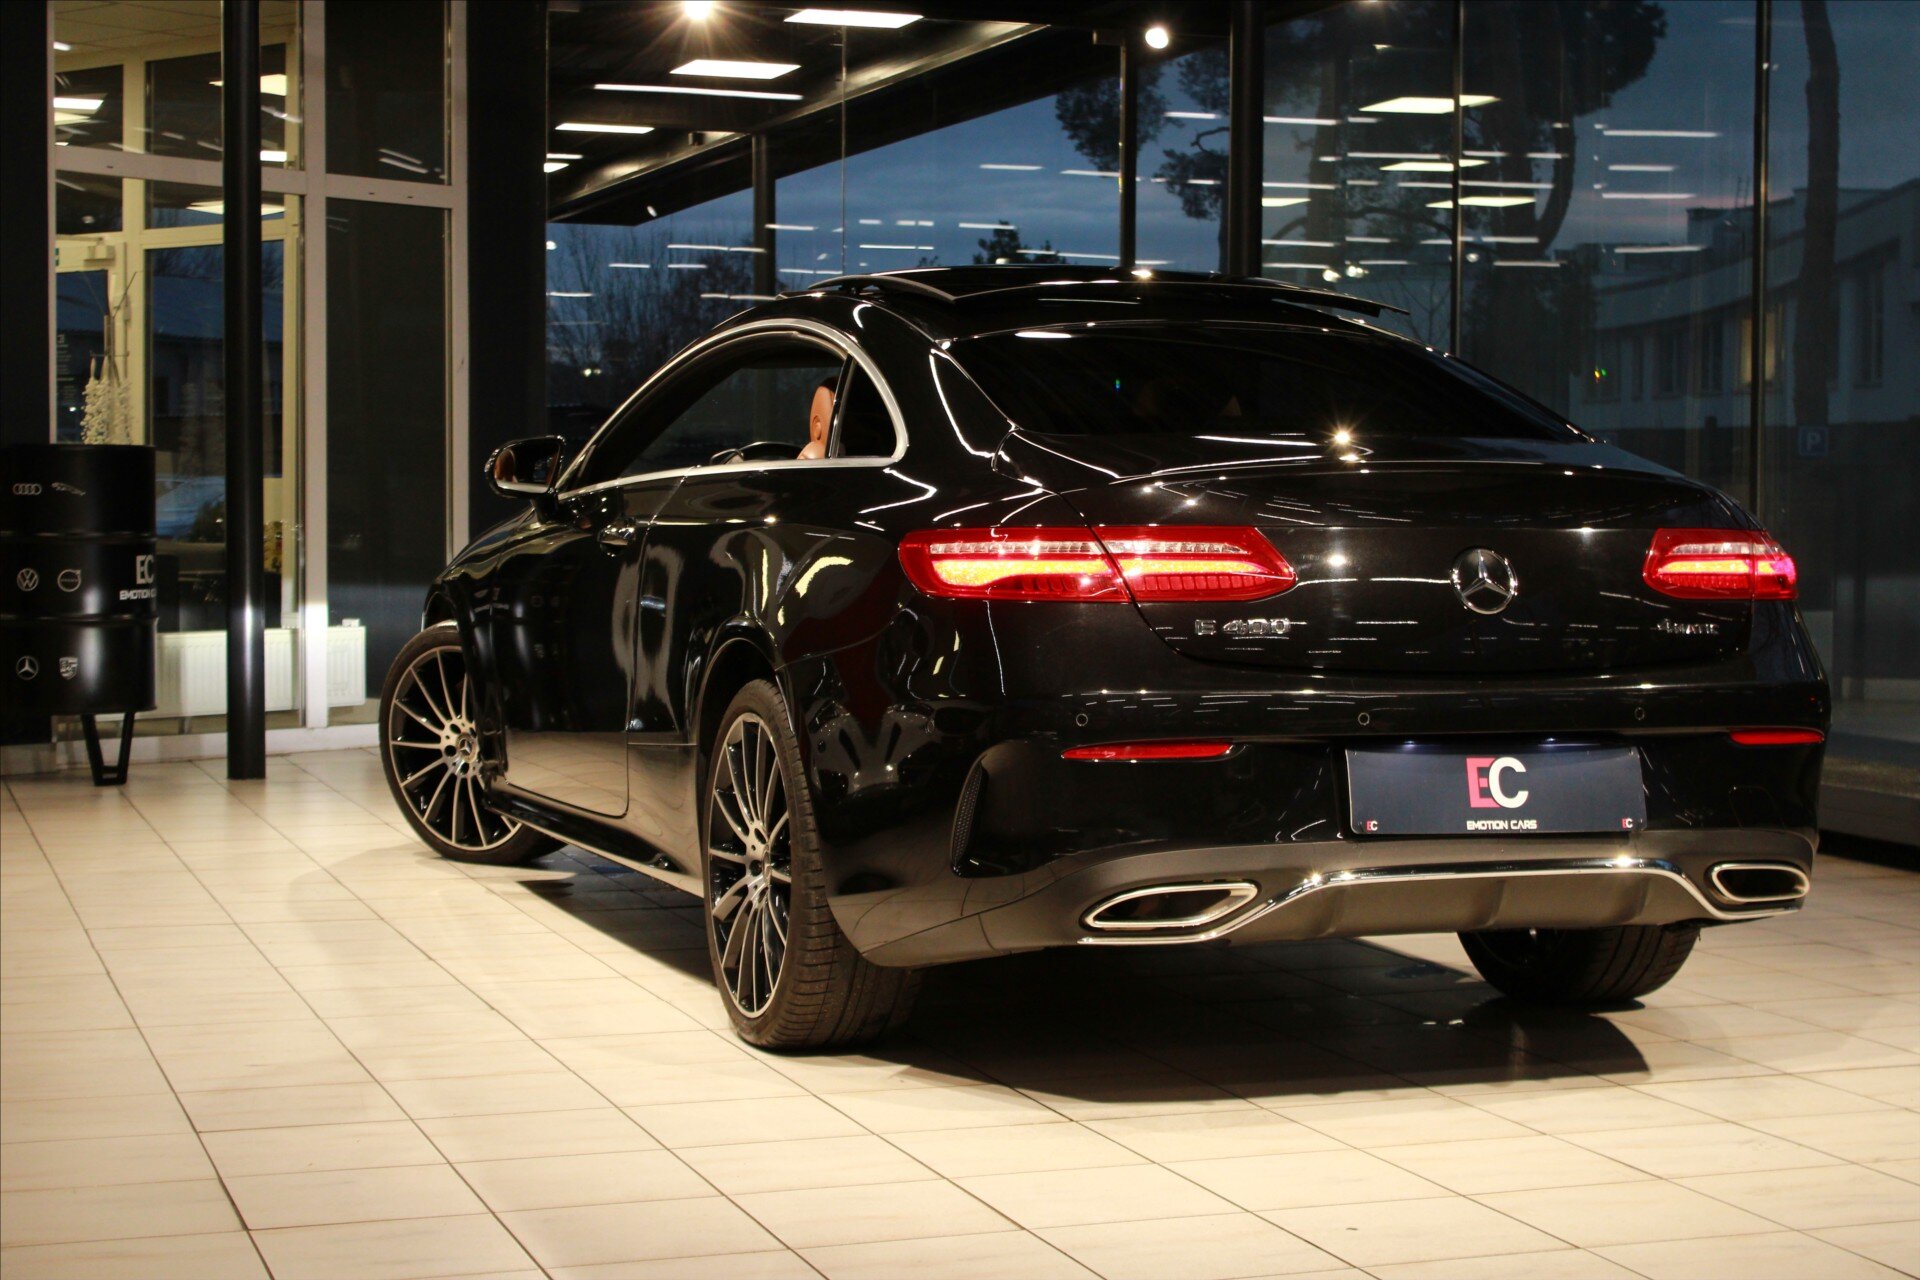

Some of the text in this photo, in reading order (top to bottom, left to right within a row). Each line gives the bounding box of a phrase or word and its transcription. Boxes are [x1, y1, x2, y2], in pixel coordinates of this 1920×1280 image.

[1807, 432, 1821, 450] P
[136, 554, 155, 585] EC
[1195, 618, 1291, 635] E 400
[1466, 756, 1529, 808] EC
[1366, 820, 1378, 831] EC
[1466, 820, 1538, 830] EMOTION CARS
[1621, 818, 1633, 828] EC
